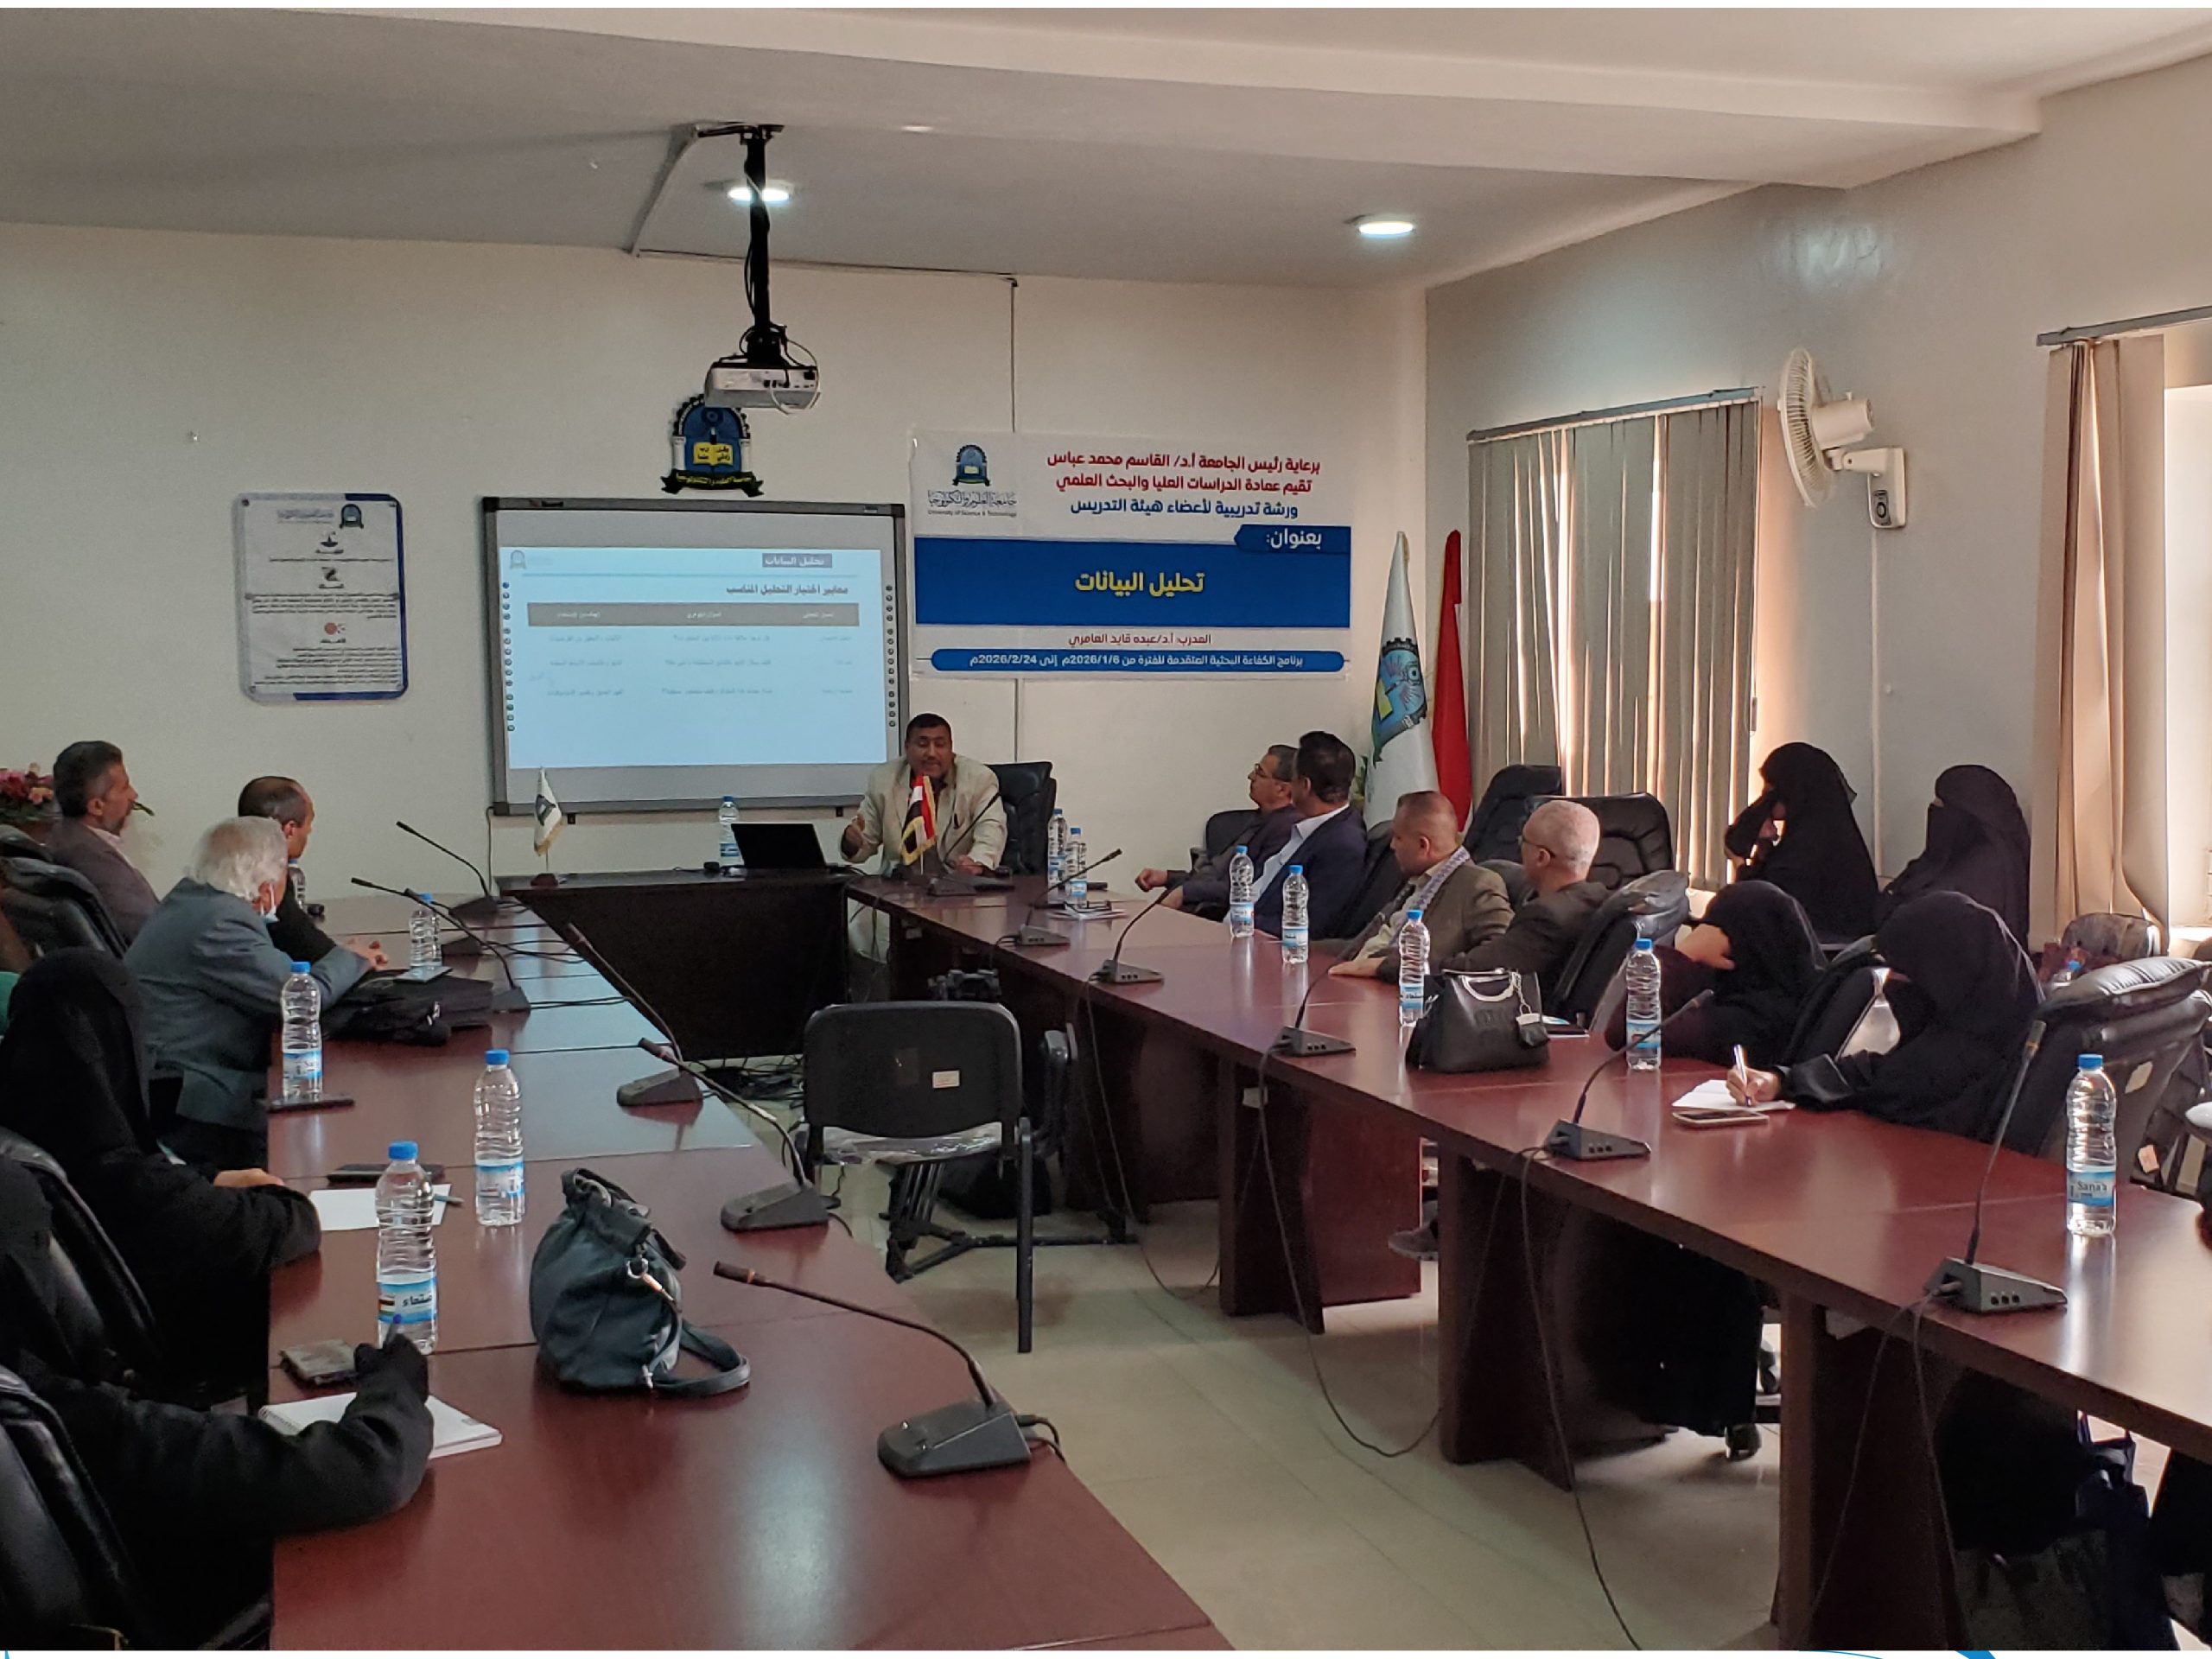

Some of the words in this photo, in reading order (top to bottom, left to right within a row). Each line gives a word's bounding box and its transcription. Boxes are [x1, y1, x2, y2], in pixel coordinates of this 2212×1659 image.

[1047, 451, 1085, 467] عباس
[1088, 454, 1122, 465] محمد
[1126, 454, 1169, 469] القاسم
[1198, 455, 1245, 472] الجامعة
[1248, 456, 1282, 474] رئيس
[1285, 458, 1320, 474] برعاية
[1057, 474, 1102, 492] العلمي
[1106, 475, 1149, 491] والبحث
[1153, 475, 1184, 492] العليا
[1187, 476, 1242, 493] الدراسات
[1245, 479, 1280, 492] عمادة
[1283, 480, 1312, 495] تقيم
[1071, 498, 1127, 515] التدريس
[1130, 499, 1163, 516] هيئة
[1166, 499, 1211, 514] لأعضاء
[1215, 500, 1260, 518] تدريبية
[1262, 501, 1298, 518] ورشة
[1266, 528, 1322, 550] بعنوان:
[1075, 570, 1144, 596] البيانات
[1149, 572, 1205, 597] تحليل
[1069, 633, 1108, 647] العامري
[1122, 656, 1136, 666] من
[1166, 655, 1207, 666] المتقدمة
[1276, 655, 1303, 667] برنامج
